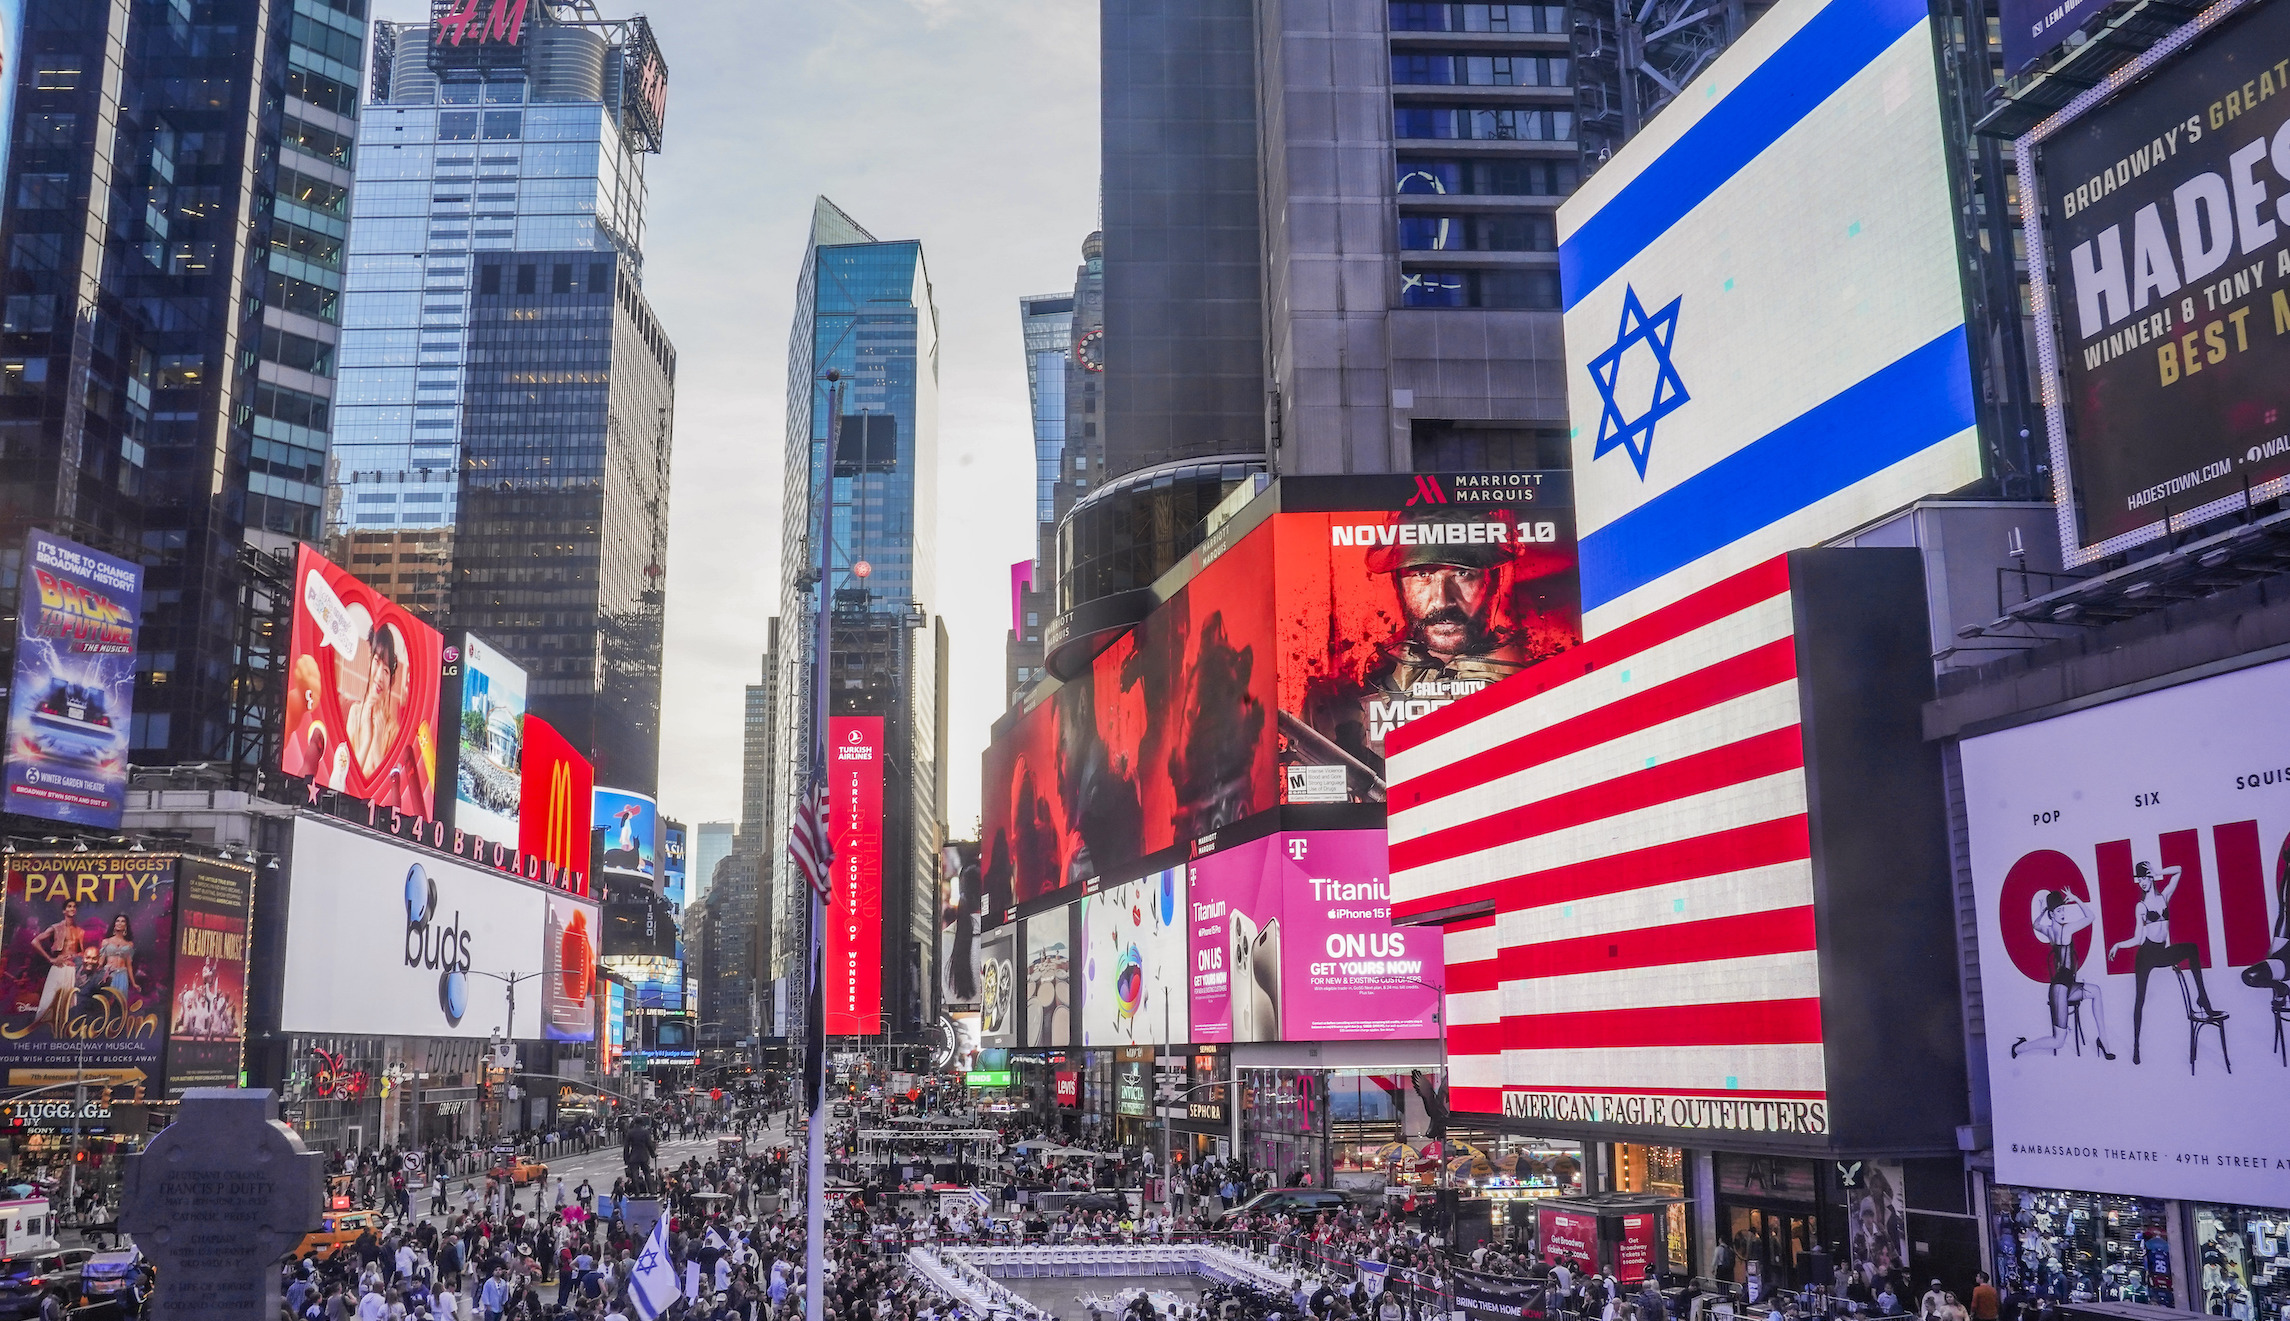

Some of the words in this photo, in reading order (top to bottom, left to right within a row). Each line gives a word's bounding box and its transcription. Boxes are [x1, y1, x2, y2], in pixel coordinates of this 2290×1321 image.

[435, 0, 529, 47] H&M
[2045, 5, 2064, 28] LENA
[2063, 115, 2202, 220] BROADWAY'S
[2083, 307, 2172, 371] WINNER!
[2181, 296, 2195, 323] 8
[2204, 260, 2264, 311] TONY
[2157, 305, 2250, 387] BEST
[1455, 474, 1544, 486] MARRIOTT
[2127, 457, 2231, 511] HADESTOWN.COM
[1456, 489, 1534, 501] MARQUIS
[1331, 523, 1507, 546] NOVEMBER
[1517, 521, 1556, 543] 10
[36, 551, 92, 578] BROADWAY
[93, 572, 135, 593] HISTORY!
[37, 541, 56, 556] IT'S
[58, 548, 81, 564] TIME
[82, 557, 96, 569] TO
[97, 563, 135, 582] CHANGE
[34, 568, 133, 624] BACK
[41, 607, 61, 626] TO
[60, 612, 133, 644] FUTURE
[83, 643, 98, 653] THE
[99, 645, 130, 654] MUSICAL
[443, 666, 458, 676] LG
[1412, 681, 1444, 696] CALL
[16, 786, 48, 797] BROADWAY
[40, 772, 62, 785] WINTER
[62, 776, 83, 789] GARDEN
[84, 780, 105, 793] THEATRE
[2033, 810, 2061, 826] POP
[2135, 791, 2160, 808] SIX
[367, 798, 444, 848] 1540
[454, 827, 584, 894] BROADWAY
[851, 839, 857, 847] A
[1289, 839, 1307, 860] T
[11, 858, 107, 873] BROADWAY'S
[110, 858, 174, 872] BIGGEST
[24, 873, 159, 902] PARTY!
[1190, 867, 1197, 887] T
[1308, 877, 1391, 901] Titaniu
[1193, 898, 1226, 922] Titanium
[1336, 909, 1372, 919] iPhone
[1373, 908, 1385, 918] 15
[181, 927, 188, 955] A
[188, 927, 224, 959] BEAUTIFUL
[224, 932, 244, 961] NOISE
[404, 903, 472, 973] buds
[849, 926, 857, 942] OF
[1326, 933, 1365, 958] ON
[1369, 932, 1405, 957] US
[1198, 949, 1211, 972] ON
[1211, 947, 1222, 970] US
[1310, 962, 1338, 976] GET
[1339, 961, 1385, 976] YOURS
[1386, 960, 1422, 974] NOW
[848, 952, 857, 1012] WONDERS
[1194, 974, 1203, 987] GET
[1216, 971, 1228, 984] NOW
[1310, 977, 1325, 985] FOR
[1325, 977, 1342, 985] NEW
[1349, 976, 1379, 984] EXISTING
[1380, 976, 1422, 984] CUSTOMERS
[1, 986, 159, 1040] Aladdin
[13, 1042, 30, 1050] THE
[33, 1042, 47, 1050] HIT
[50, 1042, 104, 1050] BROADWAY
[106, 1042, 145, 1050] MUSICAL
[426, 1039, 484, 1074] FOREVER
[1199, 1045, 1217, 1053] SEPHORA
[1121, 1086, 1145, 1100] INVICTA
[437, 1101, 461, 1116] FOREVER
[1189, 1104, 1221, 1119] SEPHORA
[1503, 1093, 1596, 1122] AMERICAN
[1601, 1096, 1666, 1125] EAGLE
[1671, 1098, 1827, 1133] OUTFITTERS
[23, 1118, 41, 1127] NY
[2020, 1144, 2099, 1158] AMBASSADOR
[2104, 1148, 2158, 1162] THEATRE
[2176, 1153, 2209, 1166] 49TH
[2217, 1155, 2267, 1169] STREET
[159, 1183, 213, 1195] FRANCIS
[217, 1183, 224, 1195] P
[230, 1182, 275, 1195] DUFFY
[223, 1211, 258, 1221] PRIEST
[1551, 1234, 1560, 1244] Get
[1560, 1236, 1585, 1248] Broadway
[1620, 1244, 1647, 1252] Broadway
[1456, 1296, 1478, 1308] BRING
[1477, 1300, 1499, 1312] THEM
[1499, 1304, 1521, 1316] HOME
